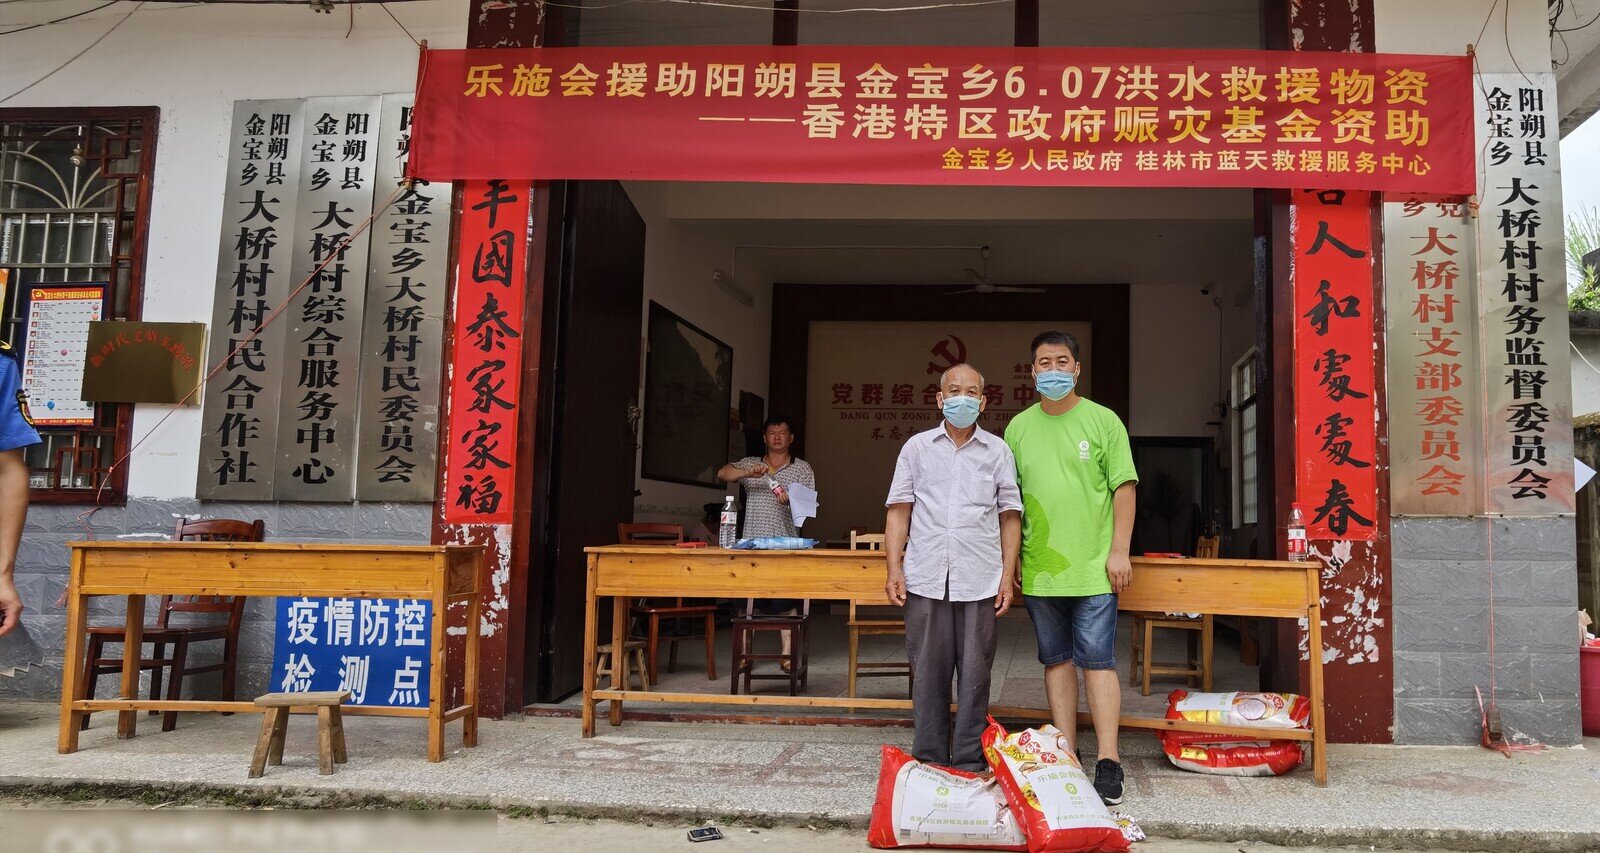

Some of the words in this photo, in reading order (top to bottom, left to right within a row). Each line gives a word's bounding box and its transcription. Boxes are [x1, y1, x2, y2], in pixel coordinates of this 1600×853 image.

[464, 62, 1428, 106] 乐施会援助阳朔县金宝乡6.07洪水救援物资
[239, 112, 266, 186] 金宝乡
[264, 113, 291, 186] 阳朔县
[309, 112, 339, 191] 金宝乡
[338, 112, 370, 190] 阳朔县
[942, 147, 1122, 172] 金宝乡人民政府
[1135, 149, 1431, 176] 桂林市蓝天救援服务中心
[1485, 86, 1513, 167] 金宝乡
[1518, 87, 1549, 167] 阳朔县
[213, 190, 280, 486] 大桥村村民合作社
[292, 201, 355, 485] 大桥村综合服务中心
[1410, 226, 1466, 497] 大桥村支部委员会
[1496, 177, 1550, 500] 大桥村村务监督委员会
[840, 412, 869, 421] DANG
[875, 412, 897, 422] QUN
[902, 412, 930, 421] ZONG
[288, 597, 426, 647] 疫情防控
[282, 653, 422, 705] 检测点
